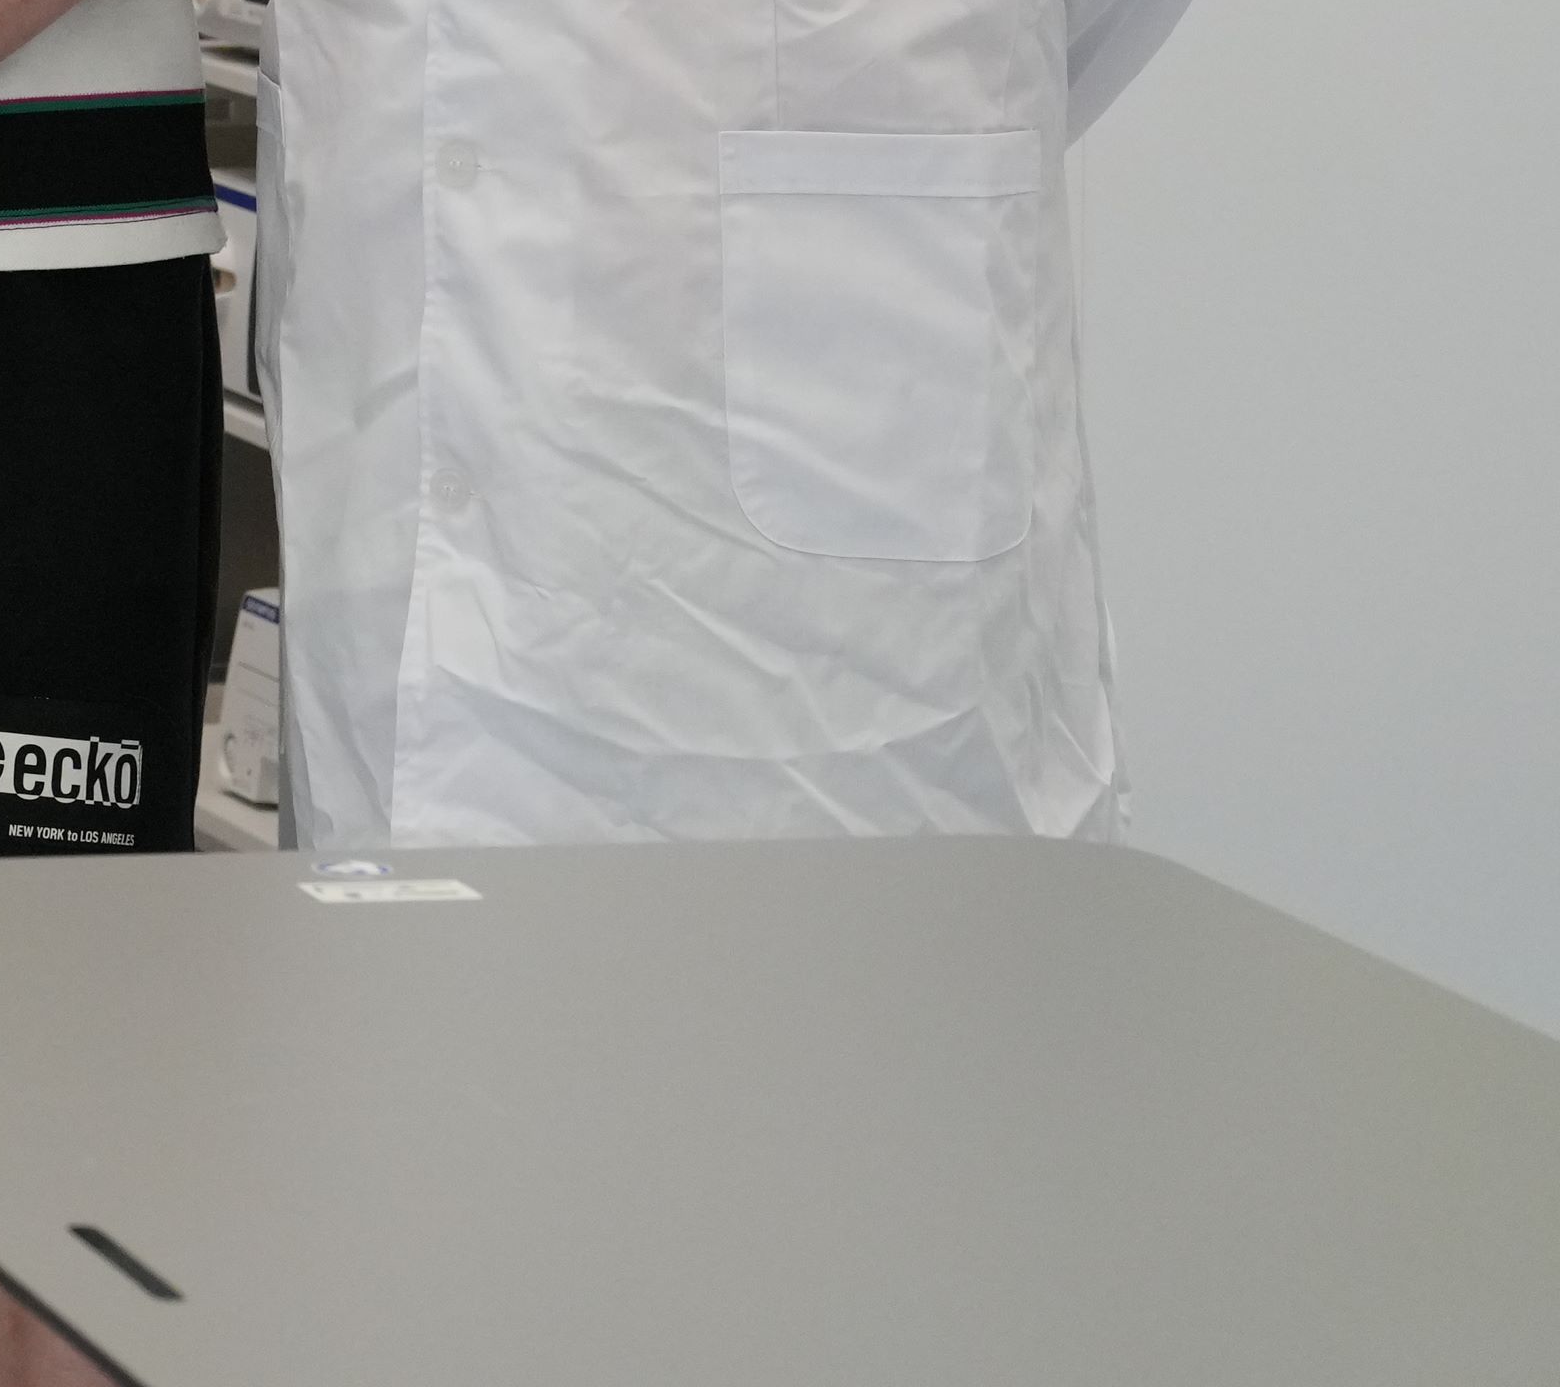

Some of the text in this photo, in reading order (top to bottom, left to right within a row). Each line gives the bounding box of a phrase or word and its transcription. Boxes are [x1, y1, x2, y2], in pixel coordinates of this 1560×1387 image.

[8, 824, 135, 846] NEW YORK to LOS ANGELES
